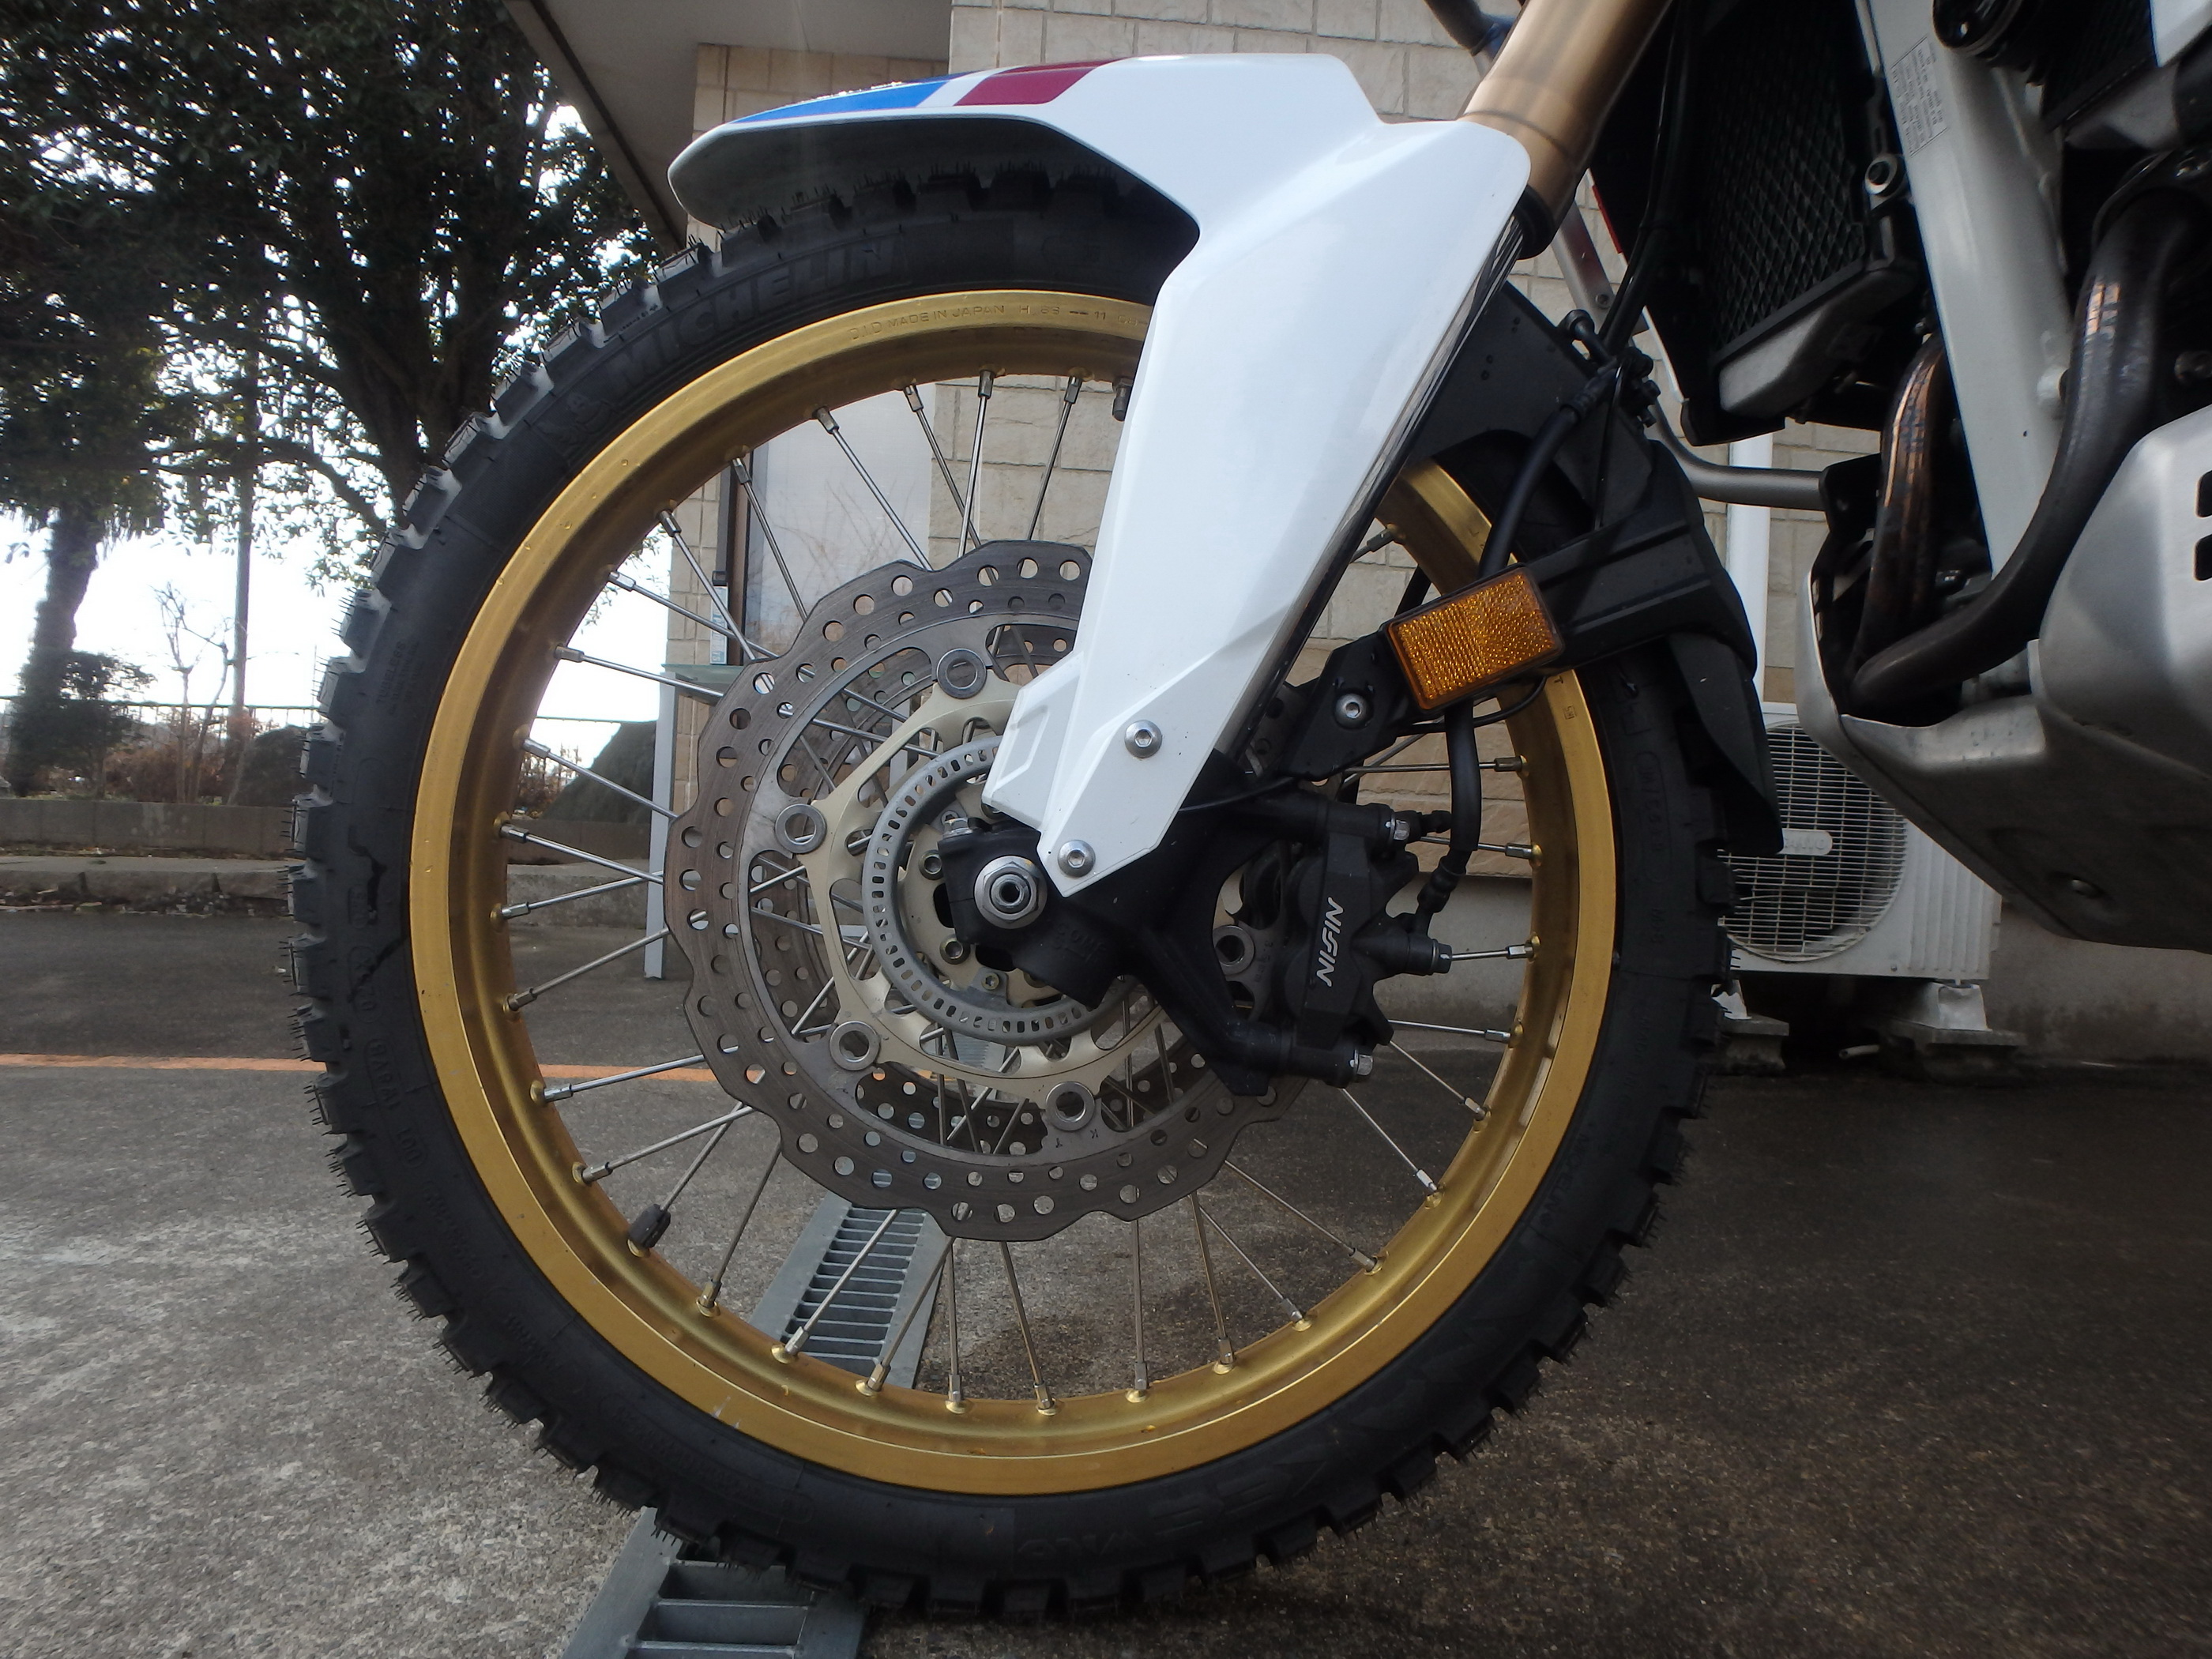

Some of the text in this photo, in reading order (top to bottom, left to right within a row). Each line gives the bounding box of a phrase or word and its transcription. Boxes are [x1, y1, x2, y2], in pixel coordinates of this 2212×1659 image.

[603, 235, 898, 393] MICHELIN
[887, 313, 930, 327] MADE
[933, 310, 947, 319] IN
[952, 305, 1005, 317] JAPAN
